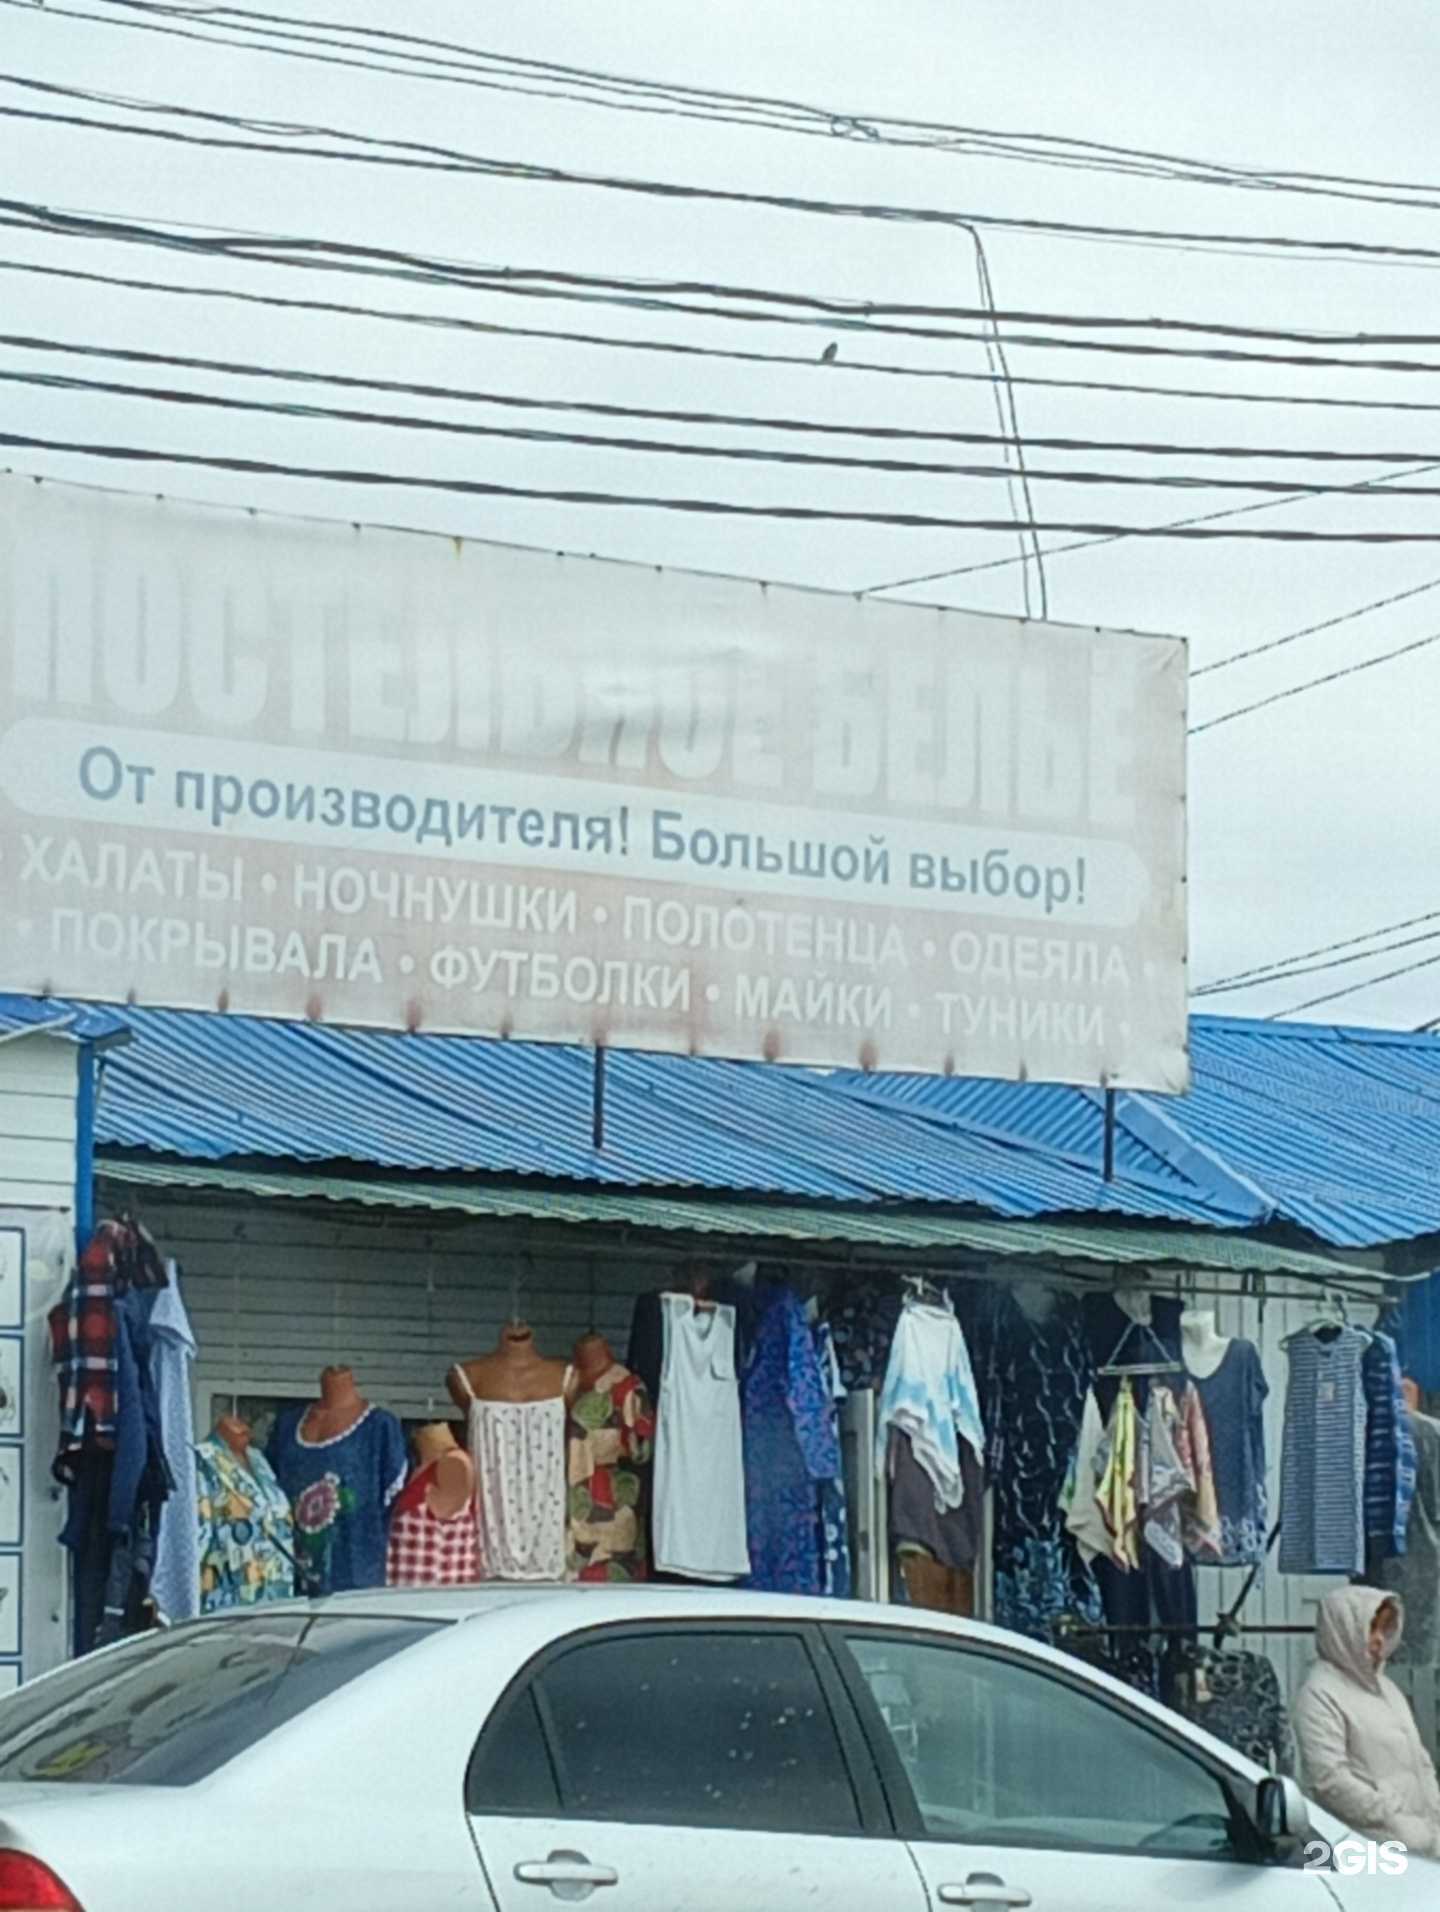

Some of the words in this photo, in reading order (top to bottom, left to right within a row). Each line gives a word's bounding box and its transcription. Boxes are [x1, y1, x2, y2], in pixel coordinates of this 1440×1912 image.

[812, 643, 1138, 826] БЕЛЬЕ
[20, 833, 244, 903] ХАЛАТЫ
[293, 862, 579, 934] НОЧНУШКИ
[622, 894, 909, 972] ПОЛОТЕНЦА
[948, 929, 1132, 987] ОДЕЯЛА
[79, 745, 155, 805] От
[174, 769, 630, 856] производителя!
[651, 808, 891, 886] Большой
[908, 849, 1087, 914] выбор!
[49, 907, 384, 984] ПОКРЫВАЛА
[429, 943, 692, 1013] ФУТБОЛКИ
[733, 970, 894, 1030] МАЙКИ
[934, 991, 1107, 1047] ТУНИКИ
